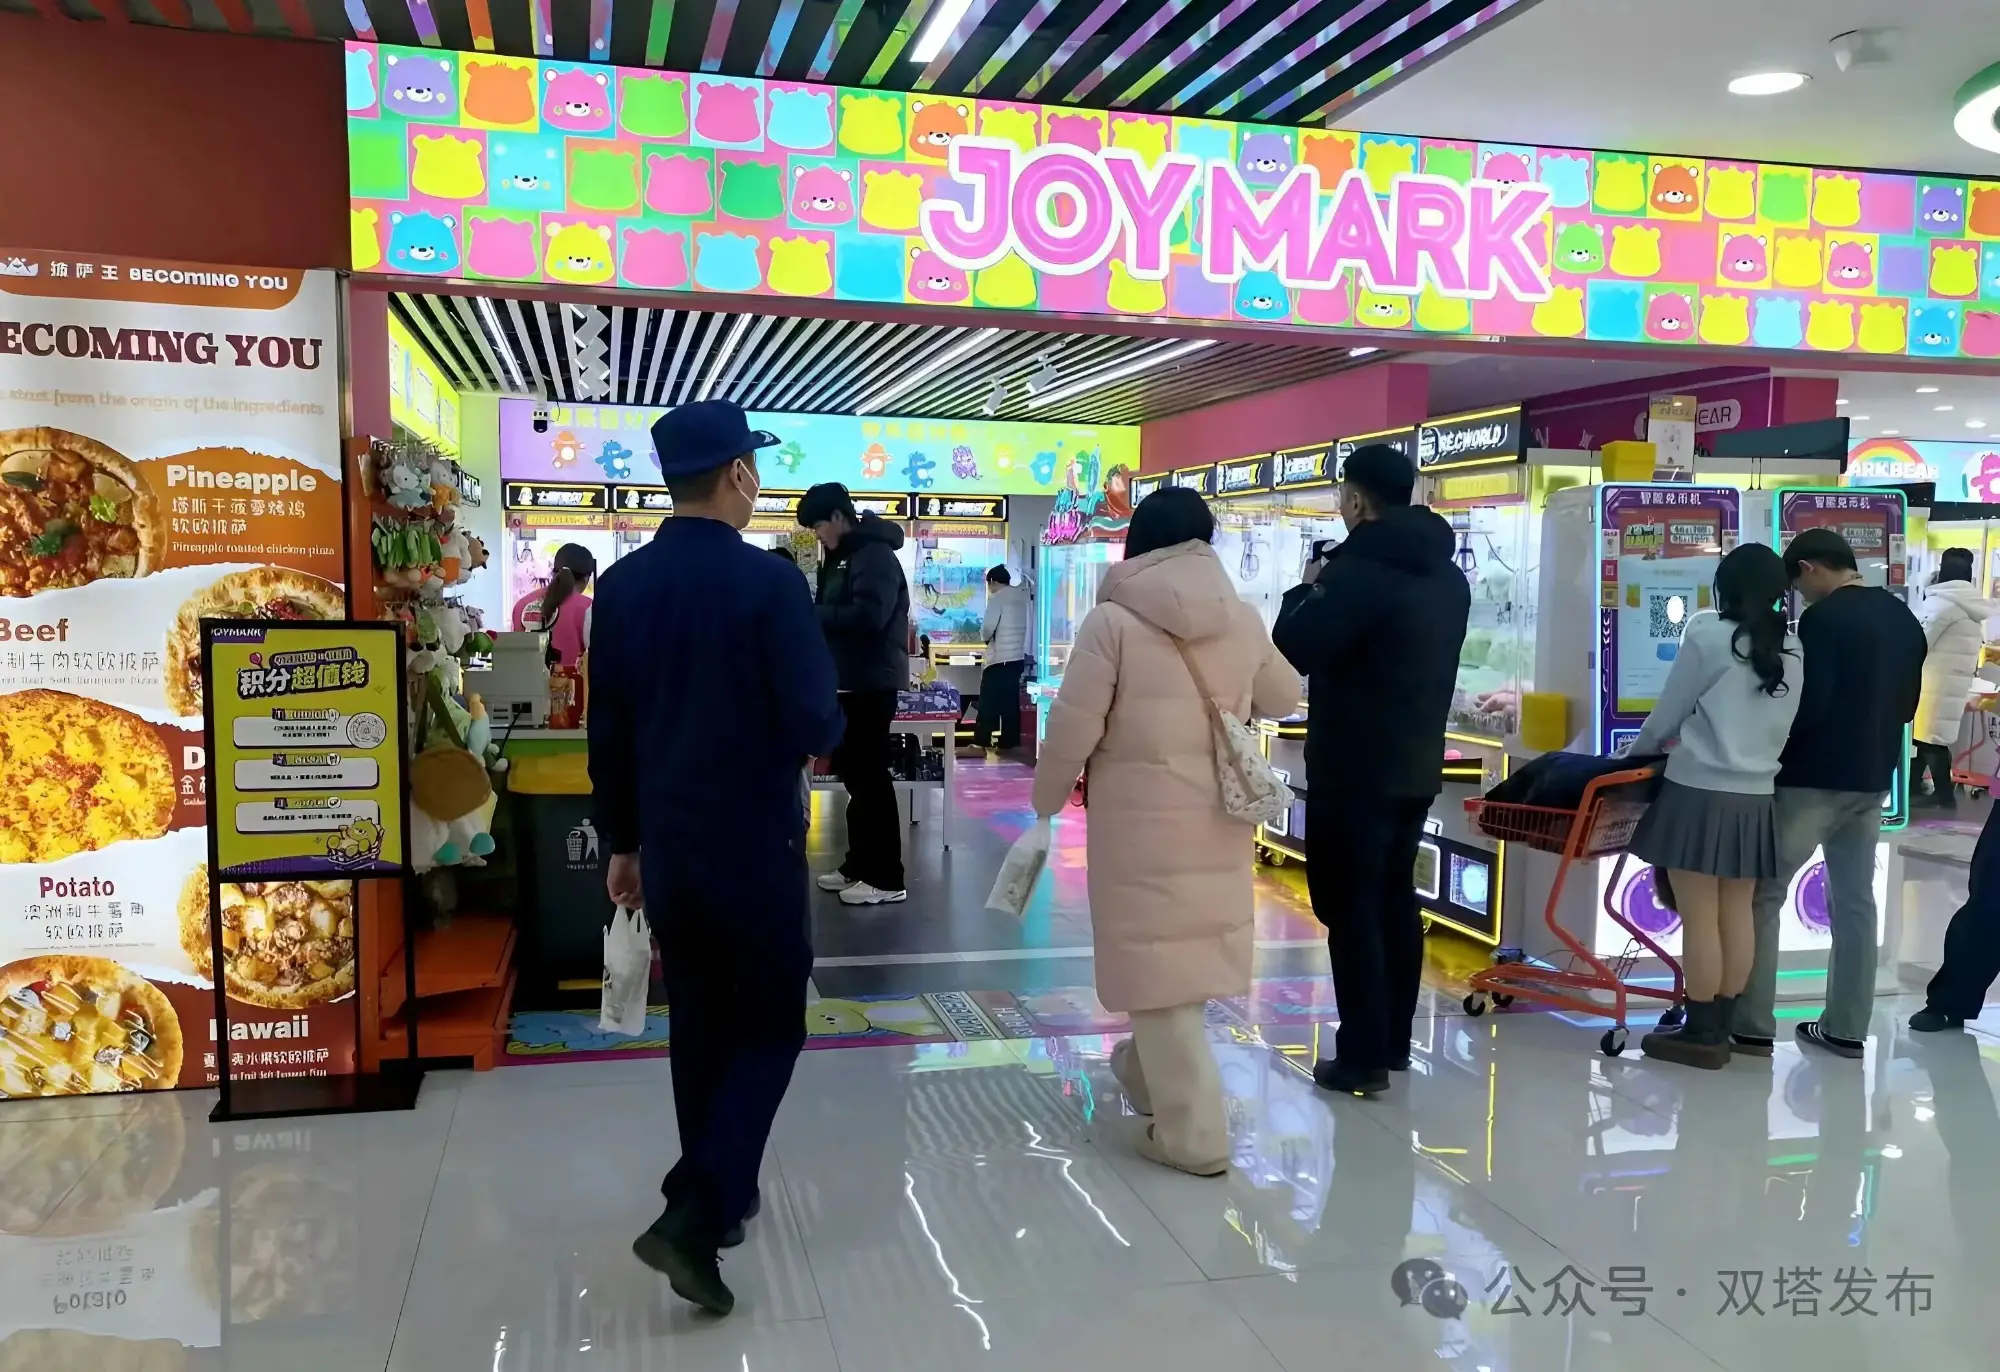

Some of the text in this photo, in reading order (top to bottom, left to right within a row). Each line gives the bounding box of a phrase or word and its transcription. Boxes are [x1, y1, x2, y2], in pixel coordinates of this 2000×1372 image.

[919, 133, 1556, 303] JOY MARK
[129, 267, 240, 288] BECOMING
[245, 275, 289, 291] YOU
[225, 334, 323, 370] YOU
[166, 464, 317, 495] Pineapple
[39, 876, 115, 898] Potato
